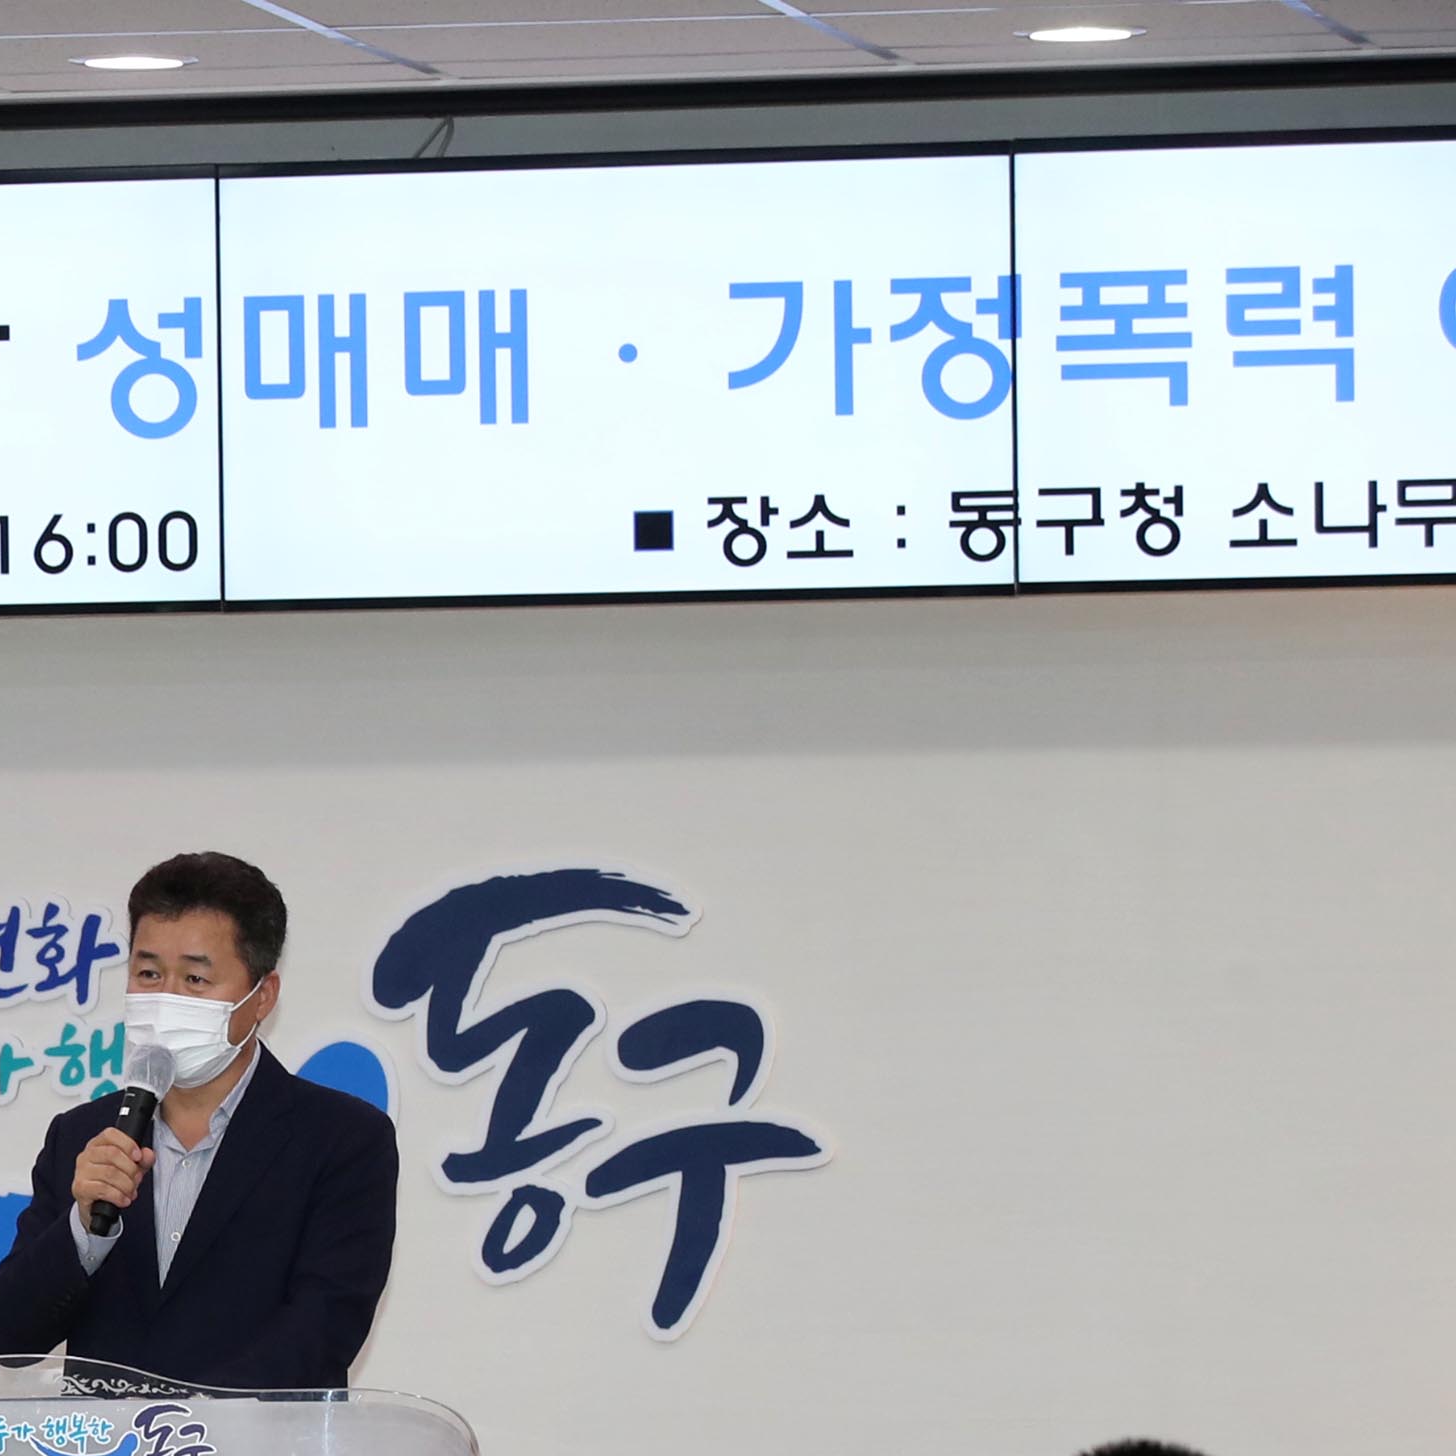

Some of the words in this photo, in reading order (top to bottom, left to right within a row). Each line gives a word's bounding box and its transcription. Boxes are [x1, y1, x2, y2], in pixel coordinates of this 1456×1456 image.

[75, 288, 532, 442] 성매매
[727, 264, 1357, 423] 가정폭력
[706, 493, 855, 568] 장소
[948, 484, 1187, 564] 동구청
[1229, 478, 1456, 550] 소나무
[371, 867, 823, 1332] 동구
[42, 1415, 112, 1454] 행복한
